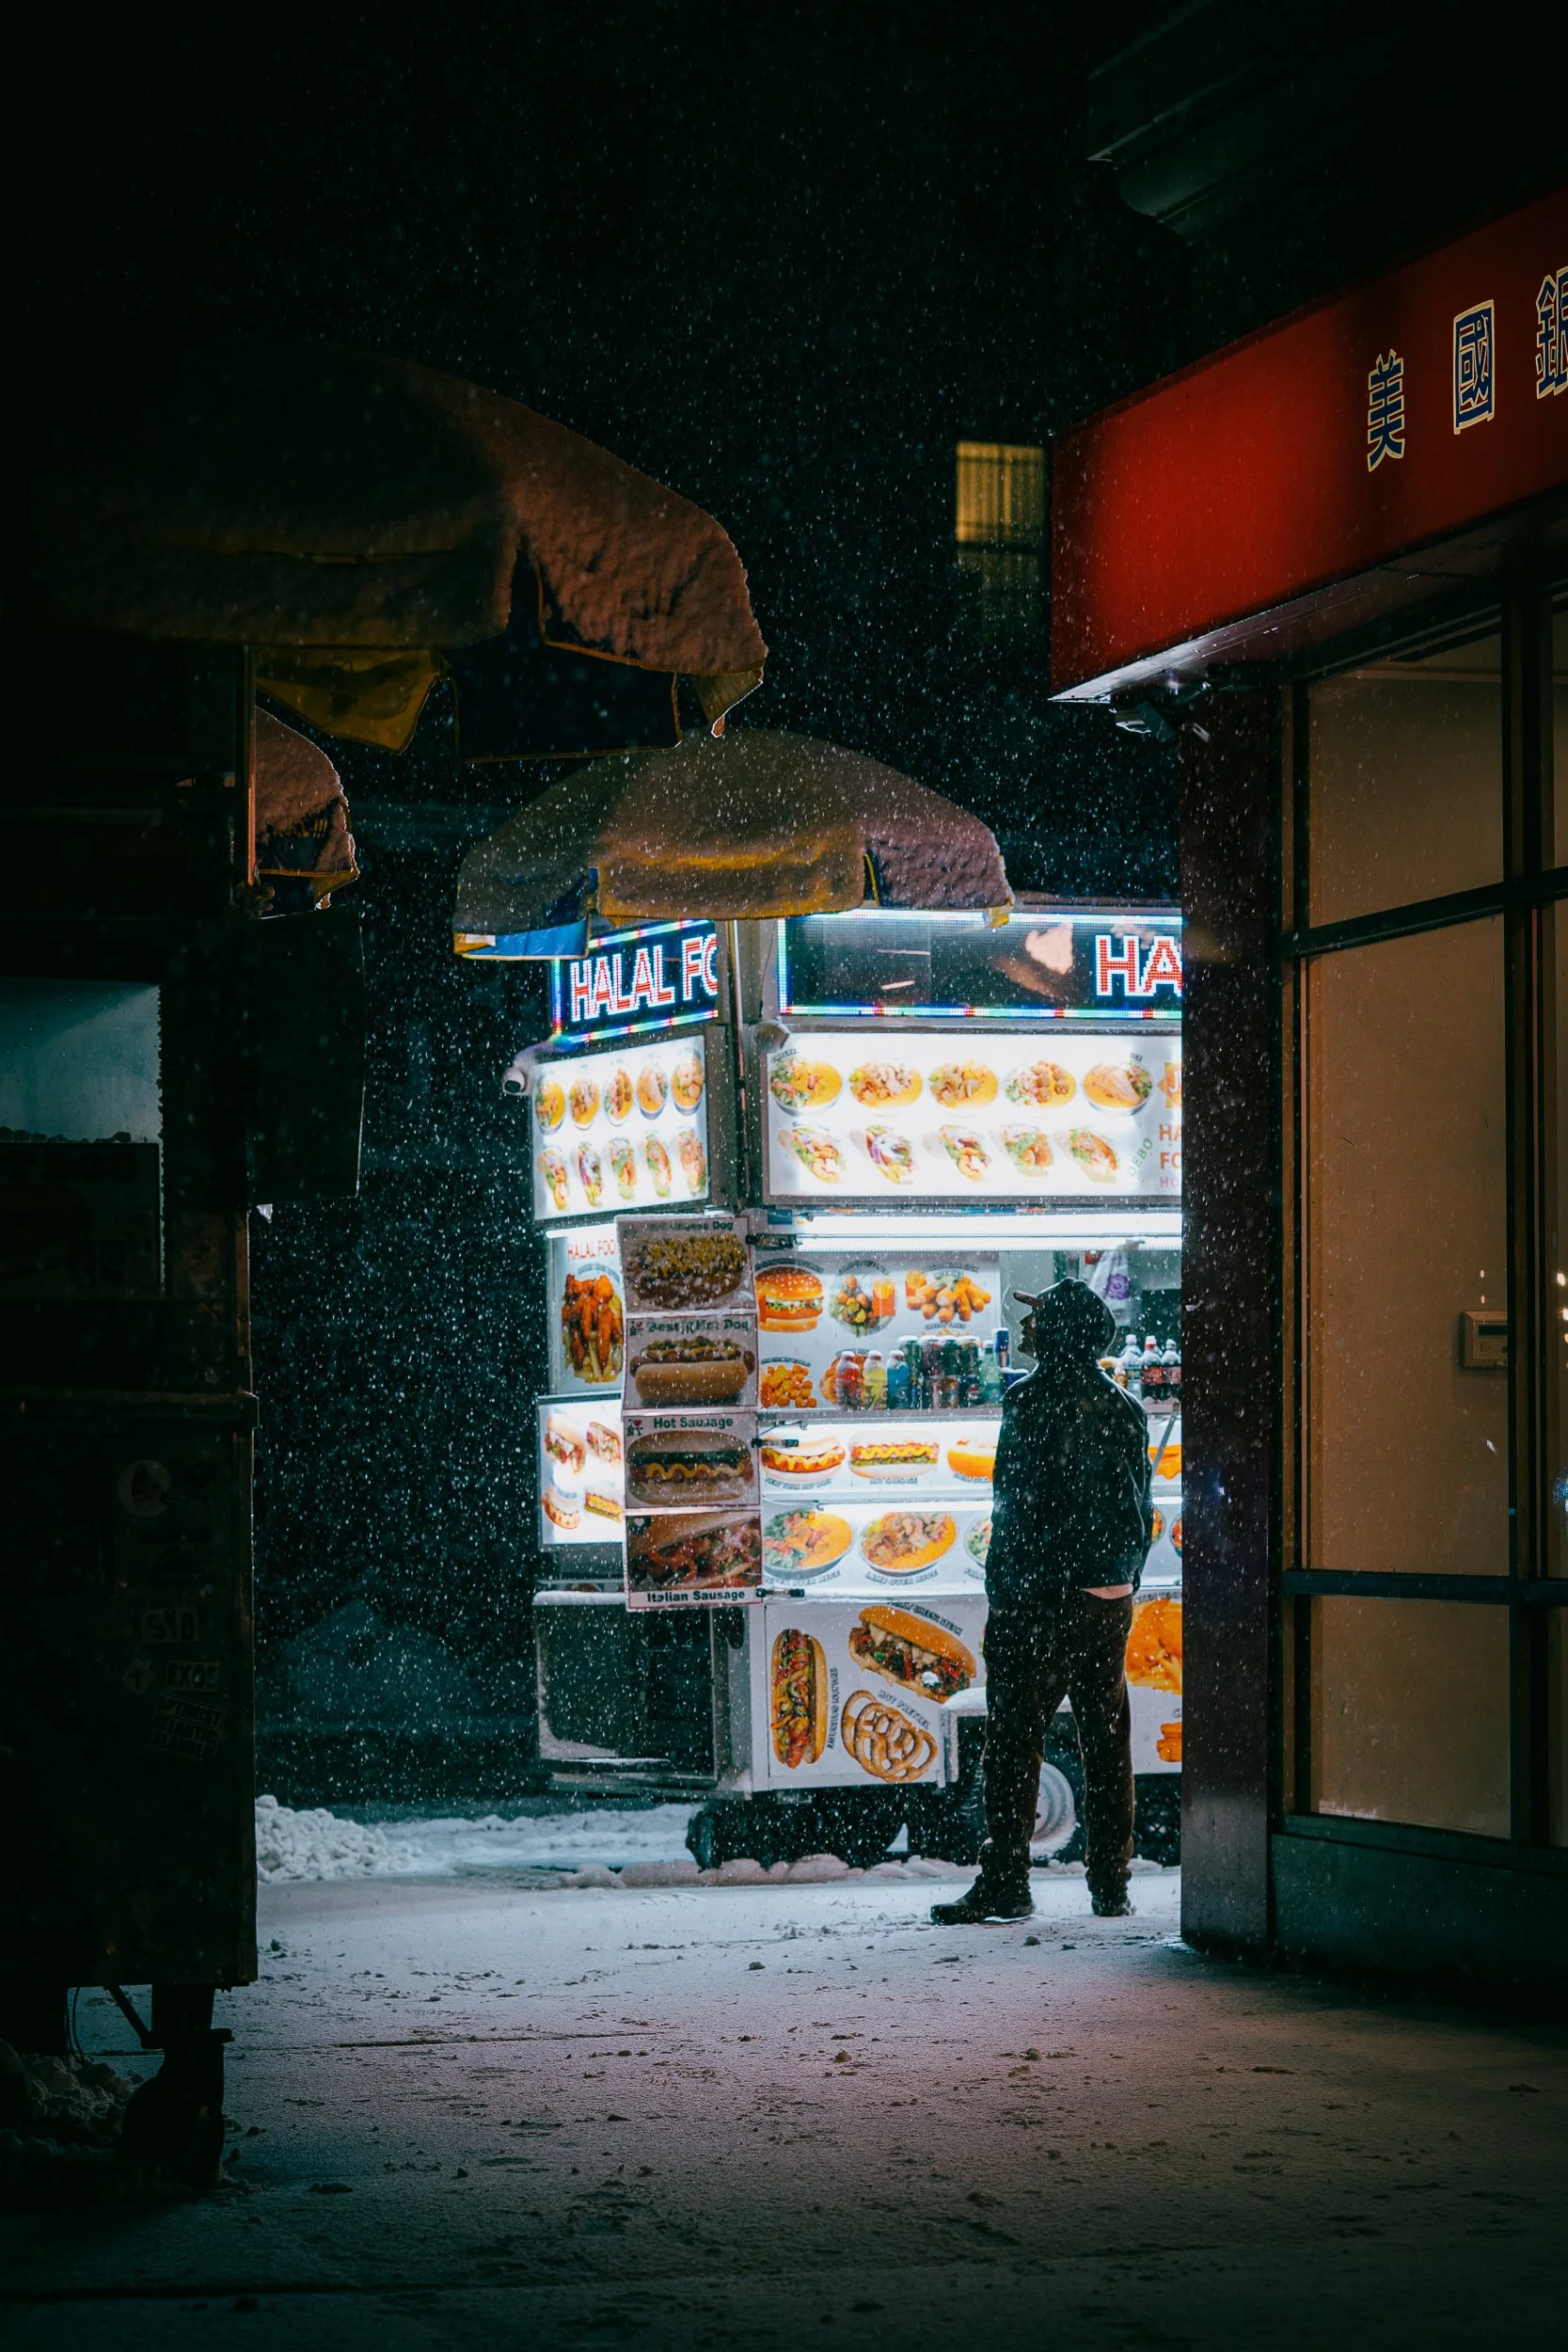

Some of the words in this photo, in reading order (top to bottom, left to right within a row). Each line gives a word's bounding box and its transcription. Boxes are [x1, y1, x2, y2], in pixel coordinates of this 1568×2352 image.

[1095, 934, 1182, 996] HA
[570, 945, 675, 1022] HALAL
[712, 1220, 734, 1232] Dog
[567, 1243, 595, 1261] HALAL
[723, 1320, 750, 1332] Dog
[653, 1418, 675, 1428] Hot
[680, 1417, 734, 1430] Sausage
[647, 1591, 689, 1603] Italian
[693, 1590, 745, 1603] Sausage
